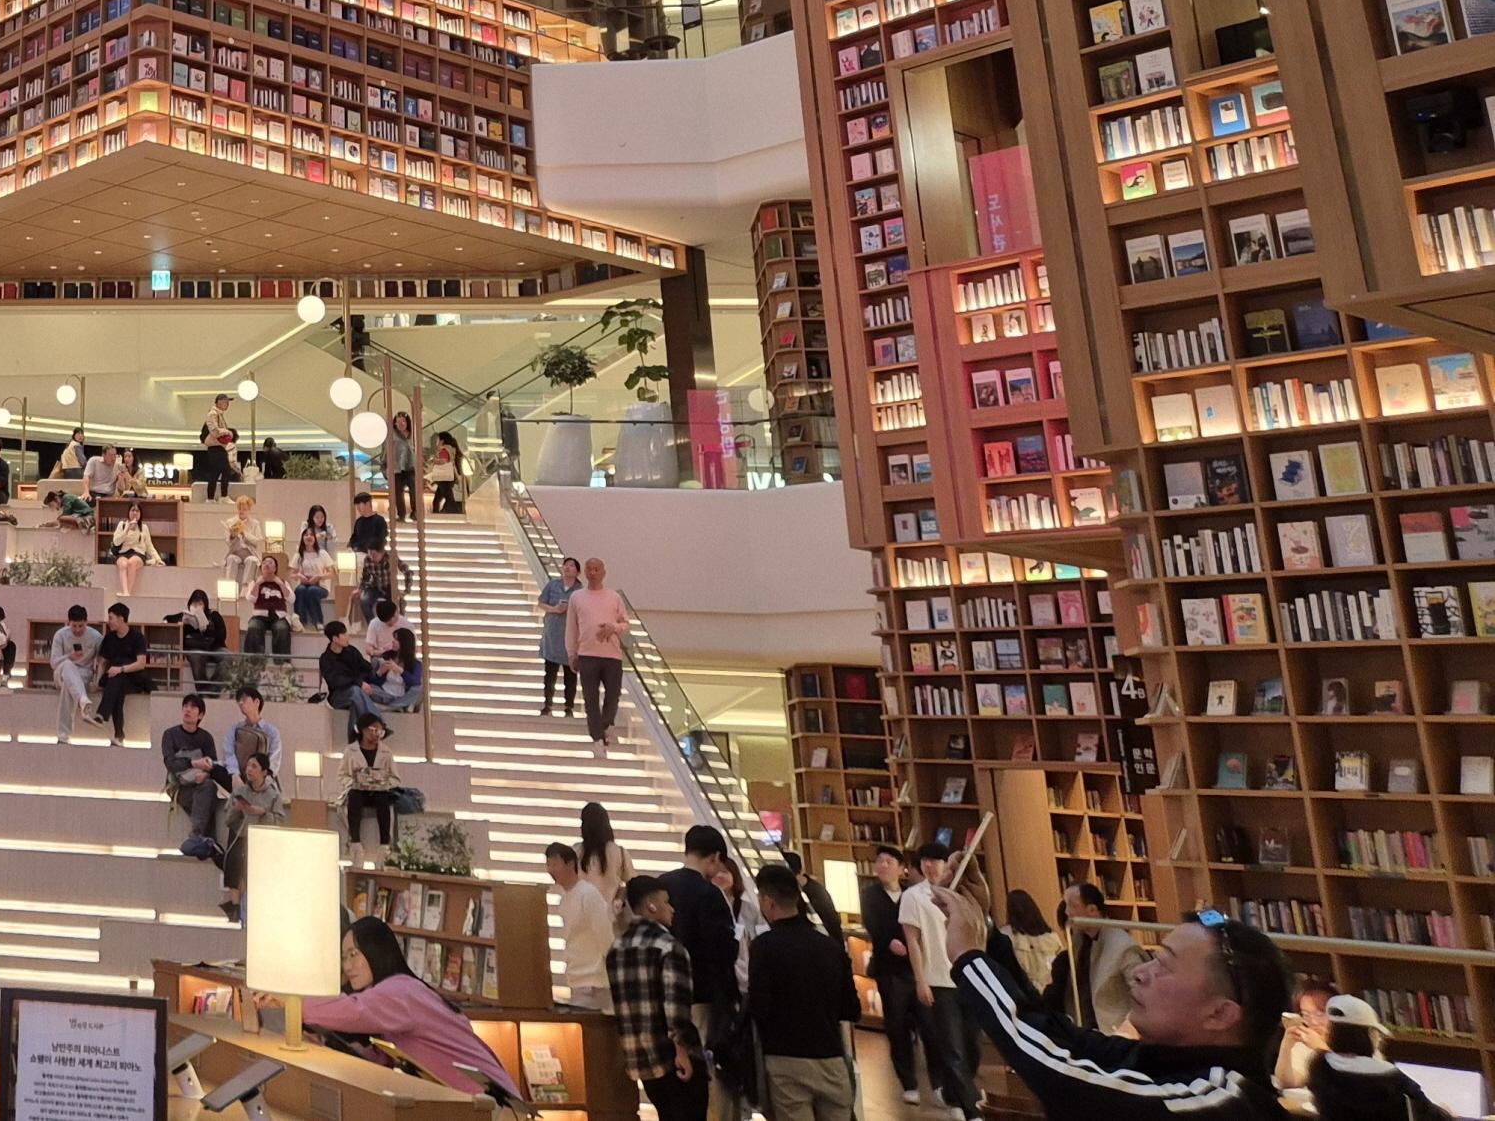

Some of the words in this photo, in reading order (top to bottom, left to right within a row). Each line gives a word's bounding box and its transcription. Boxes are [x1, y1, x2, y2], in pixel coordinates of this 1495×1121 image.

[138, 462, 178, 479] EST
[83, 1044, 120, 1056] 피아니스트
[78, 1058, 93, 1069] 세계
[95, 1059, 118, 1070] 최고의
[119, 1061, 143, 1072] 피아노
